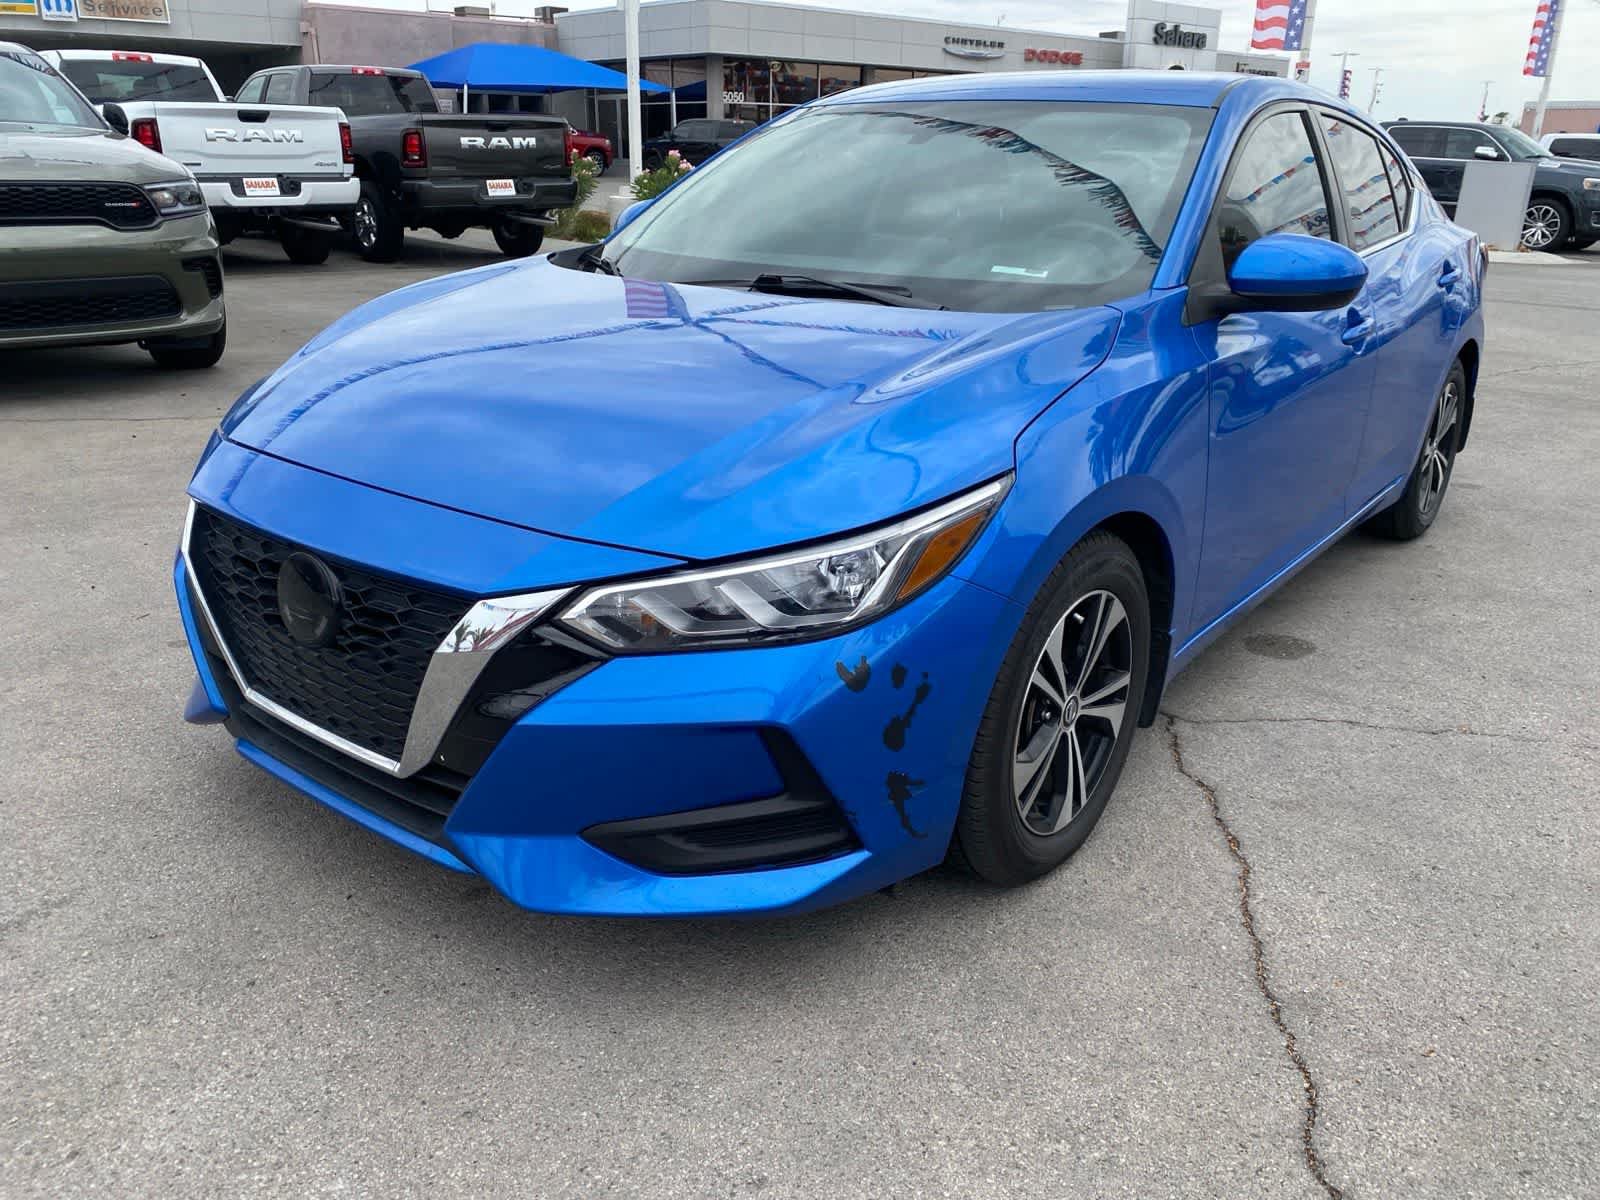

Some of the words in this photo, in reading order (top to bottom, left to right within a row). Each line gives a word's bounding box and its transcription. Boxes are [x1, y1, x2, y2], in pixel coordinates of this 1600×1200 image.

[85, 0, 163, 17] Service
[1153, 22, 1207, 49] Sahara
[944, 36, 1005, 49] CHRYSLER
[1024, 48, 1083, 65] DODGE
[723, 91, 744, 103] 5050
[205, 127, 304, 143] RAM
[460, 136, 537, 149] RAM
[245, 180, 276, 189] SAHARA
[488, 181, 513, 190] SAHARA
